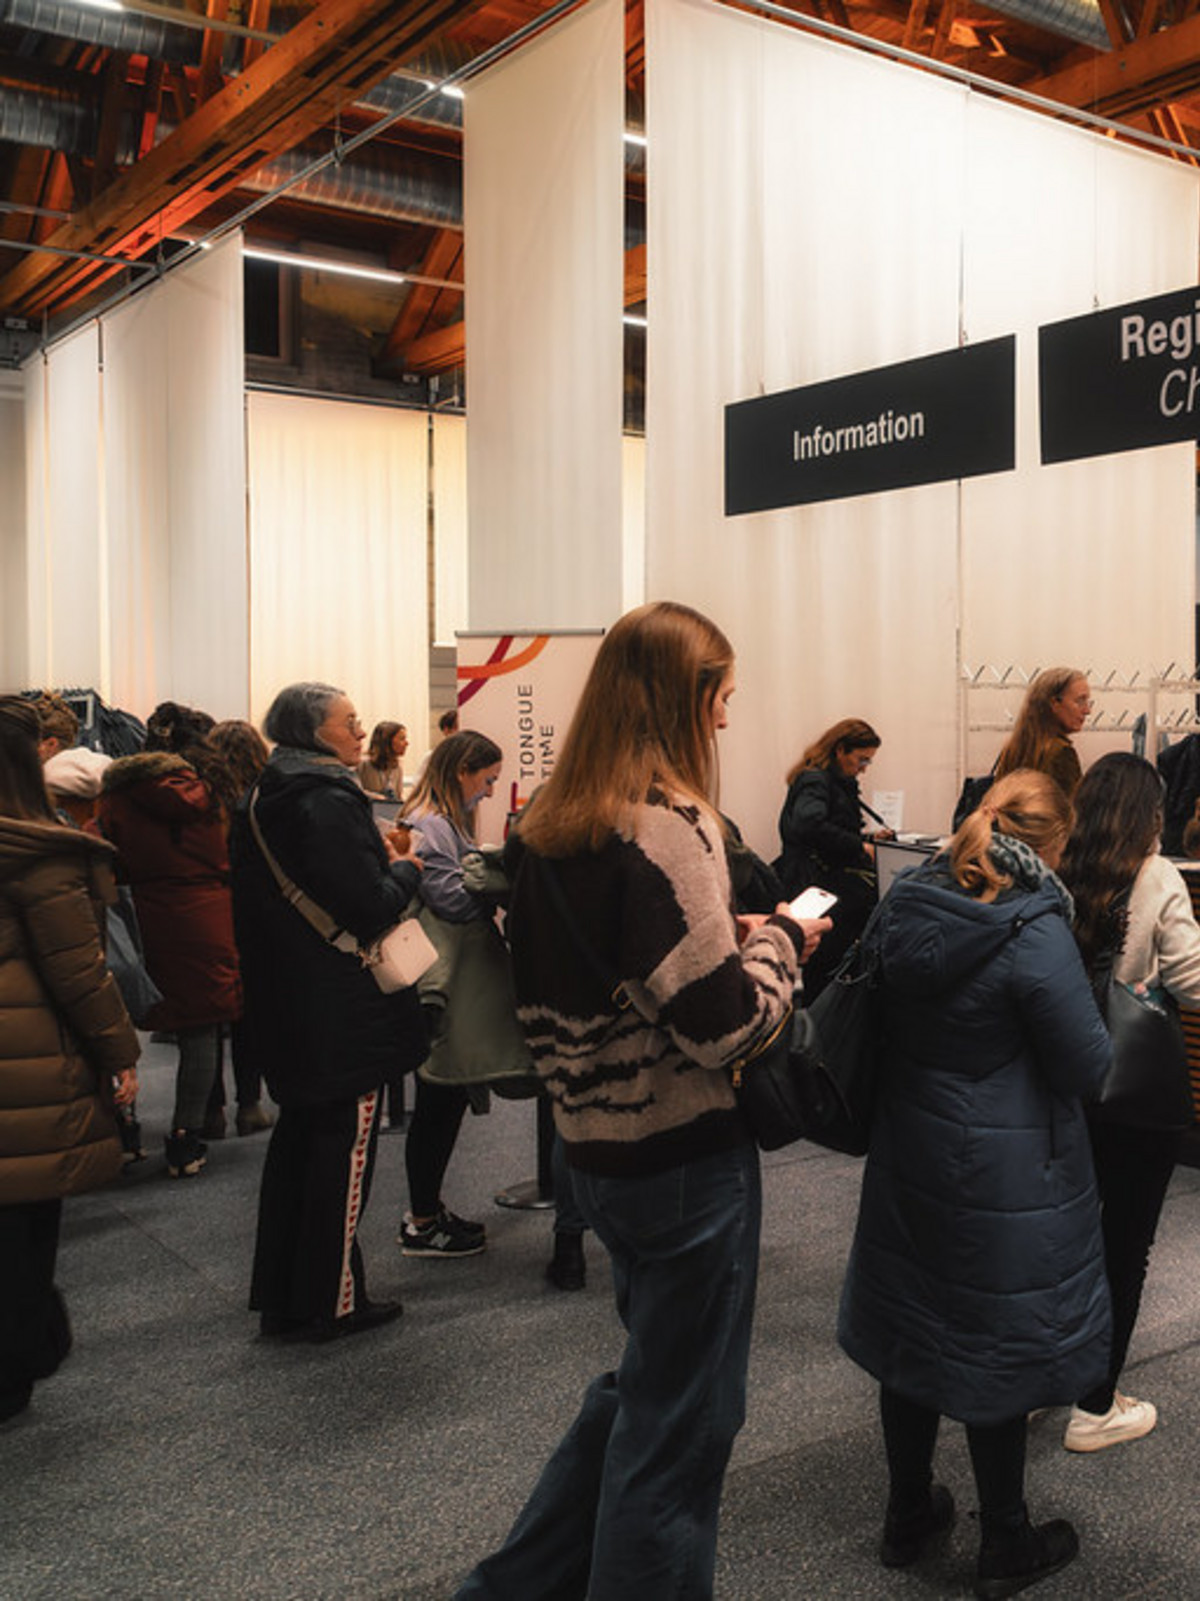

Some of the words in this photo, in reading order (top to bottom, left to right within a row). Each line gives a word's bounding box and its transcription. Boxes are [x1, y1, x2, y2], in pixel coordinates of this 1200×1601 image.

[793, 411, 924, 461] Information
[518, 685, 535, 779] TONGUE
[540, 725, 554, 779] TIME
